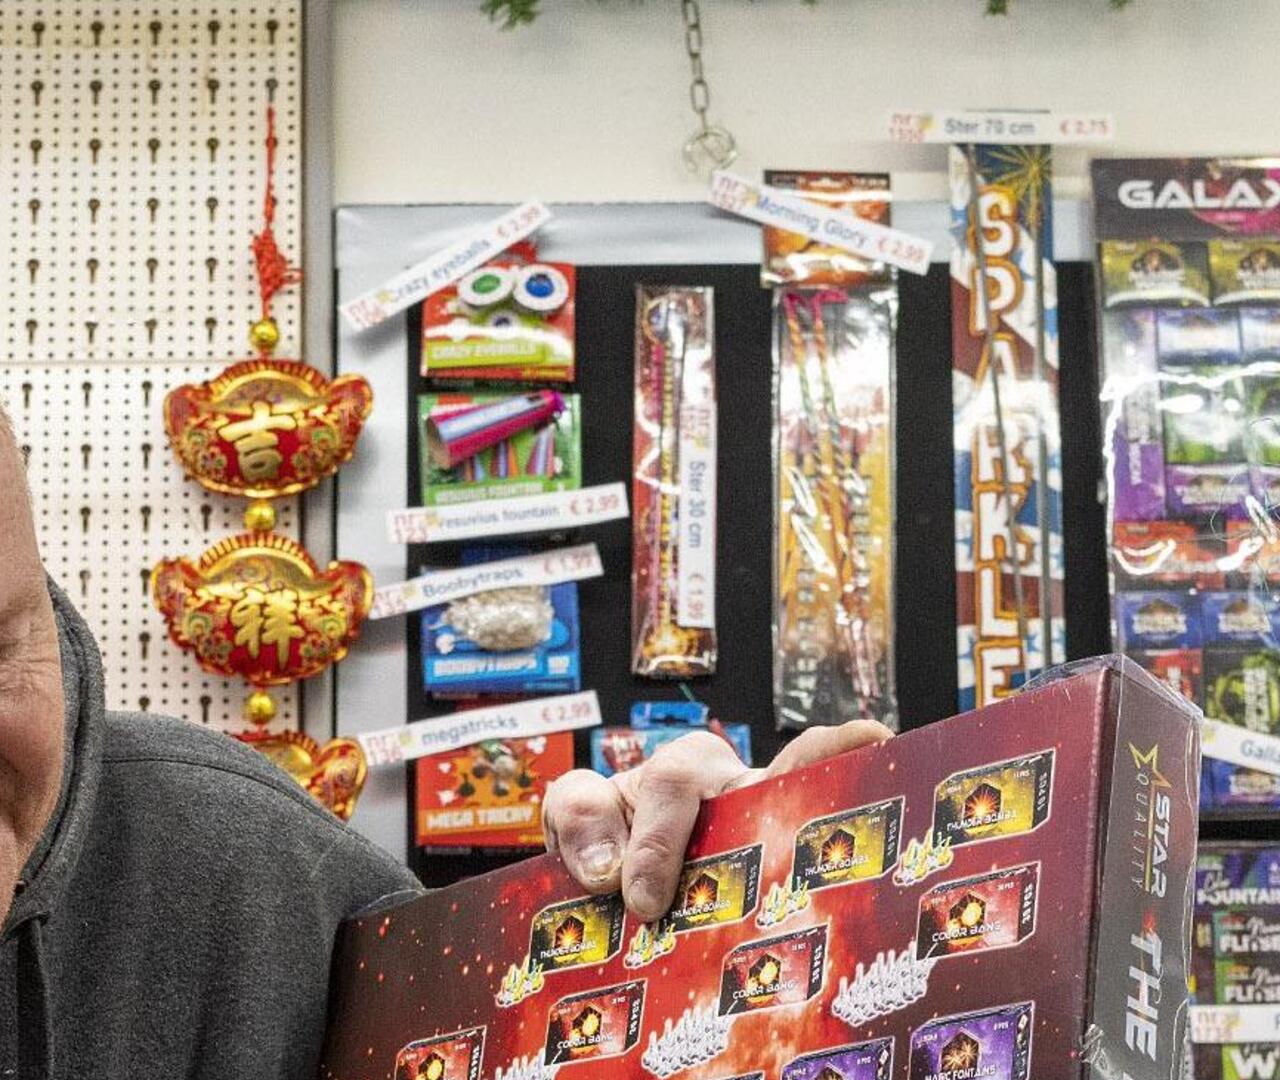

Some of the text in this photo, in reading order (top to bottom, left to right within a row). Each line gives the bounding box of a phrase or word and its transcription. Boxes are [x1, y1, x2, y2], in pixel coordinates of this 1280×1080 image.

[945, 118, 979, 134] Ster
[985, 118, 1005, 135] 70
[1009, 122, 1036, 135] cm
[758, 196, 820, 233] Morning
[823, 218, 868, 249] Glory
[432, 239, 491, 280] eyeballs
[219, 402, 297, 481] 吉
[689, 461, 707, 493] Ster
[502, 504, 561, 523] fountain
[570, 499, 581, 515] €
[688, 495, 706, 518] 30
[687, 522, 703, 549] cm
[422, 567, 524, 598] Boobytraps
[231, 589, 305, 670] 祥
[421, 716, 519, 747] megatricks
[541, 707, 553, 724] €
[1131, 772, 1151, 892] QUALITY
[1151, 791, 1171, 898] STAR
[1125, 931, 1163, 1062] THE
